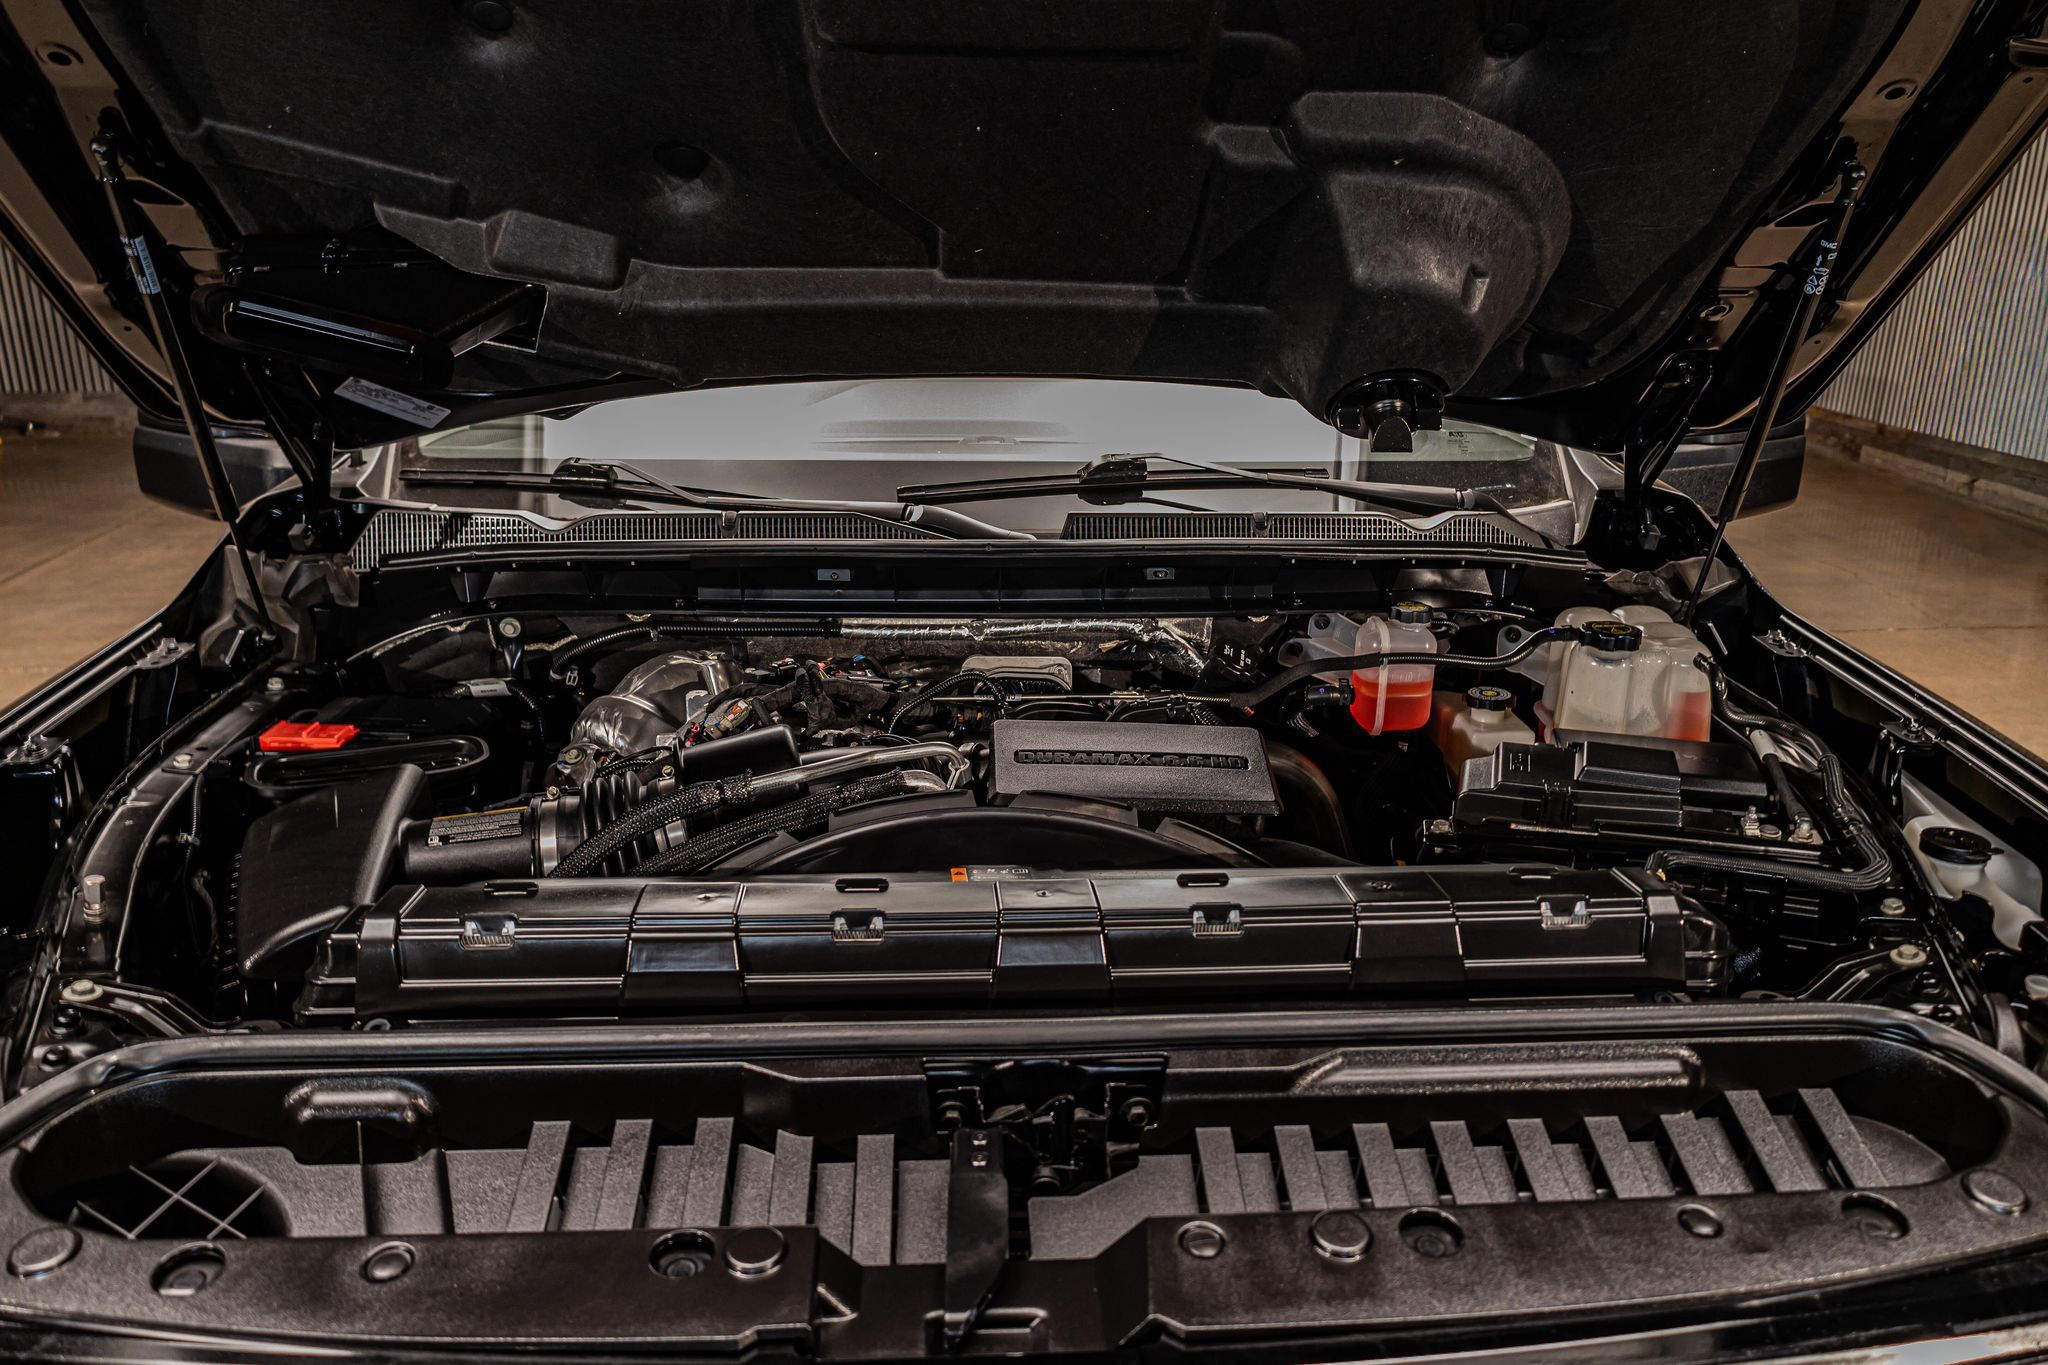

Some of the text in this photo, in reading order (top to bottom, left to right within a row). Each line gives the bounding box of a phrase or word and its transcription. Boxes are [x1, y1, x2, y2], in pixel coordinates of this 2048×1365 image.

[1017, 750, 1247, 770] DURAMAX 6.6 HD
